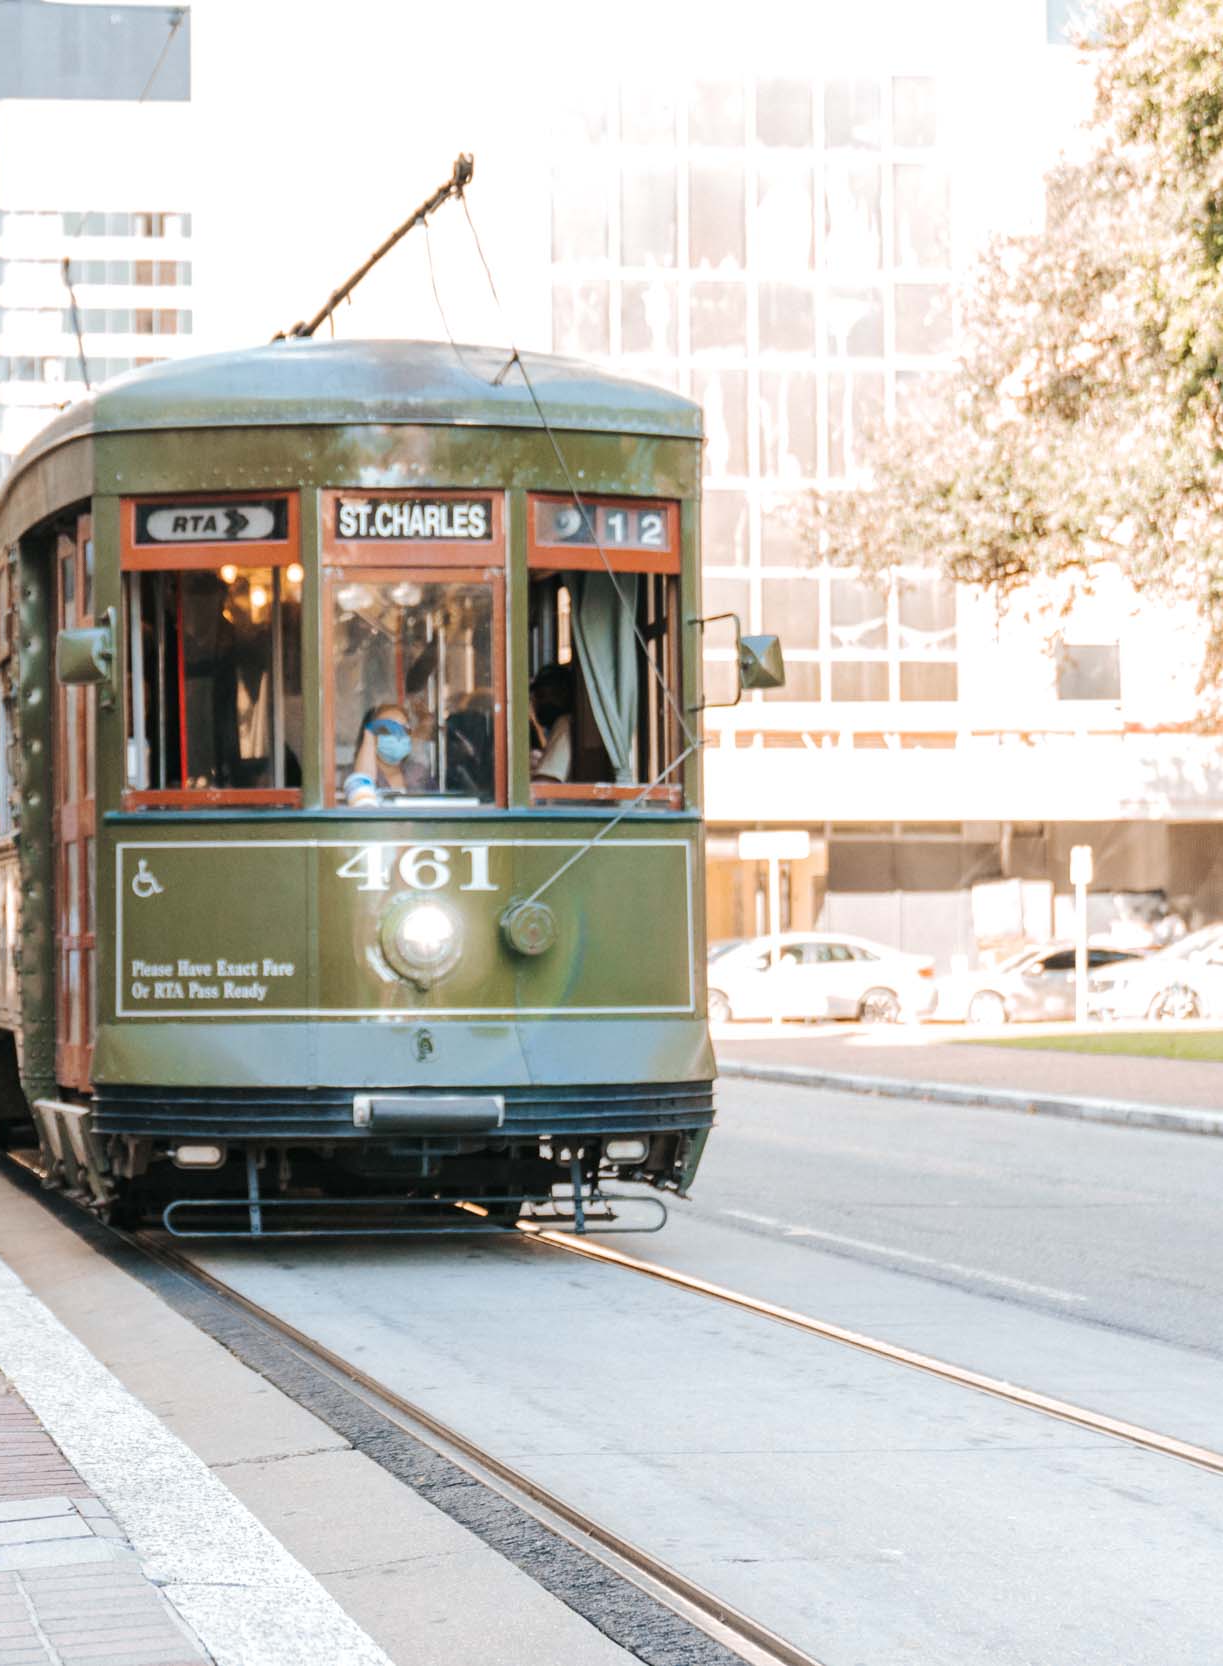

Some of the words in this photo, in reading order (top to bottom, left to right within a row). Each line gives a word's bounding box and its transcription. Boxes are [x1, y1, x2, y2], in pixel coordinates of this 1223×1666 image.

[171, 515, 217, 533] RTA
[335, 844, 500, 891] 461
[131, 959, 173, 977] Please
[177, 959, 212, 977] Have
[217, 959, 258, 976] Exact
[263, 958, 295, 976] Fare
[131, 981, 150, 999] Or
[154, 981, 185, 999] RTA
[188, 981, 219, 999] Pass
[223, 980, 268, 1001] Ready
